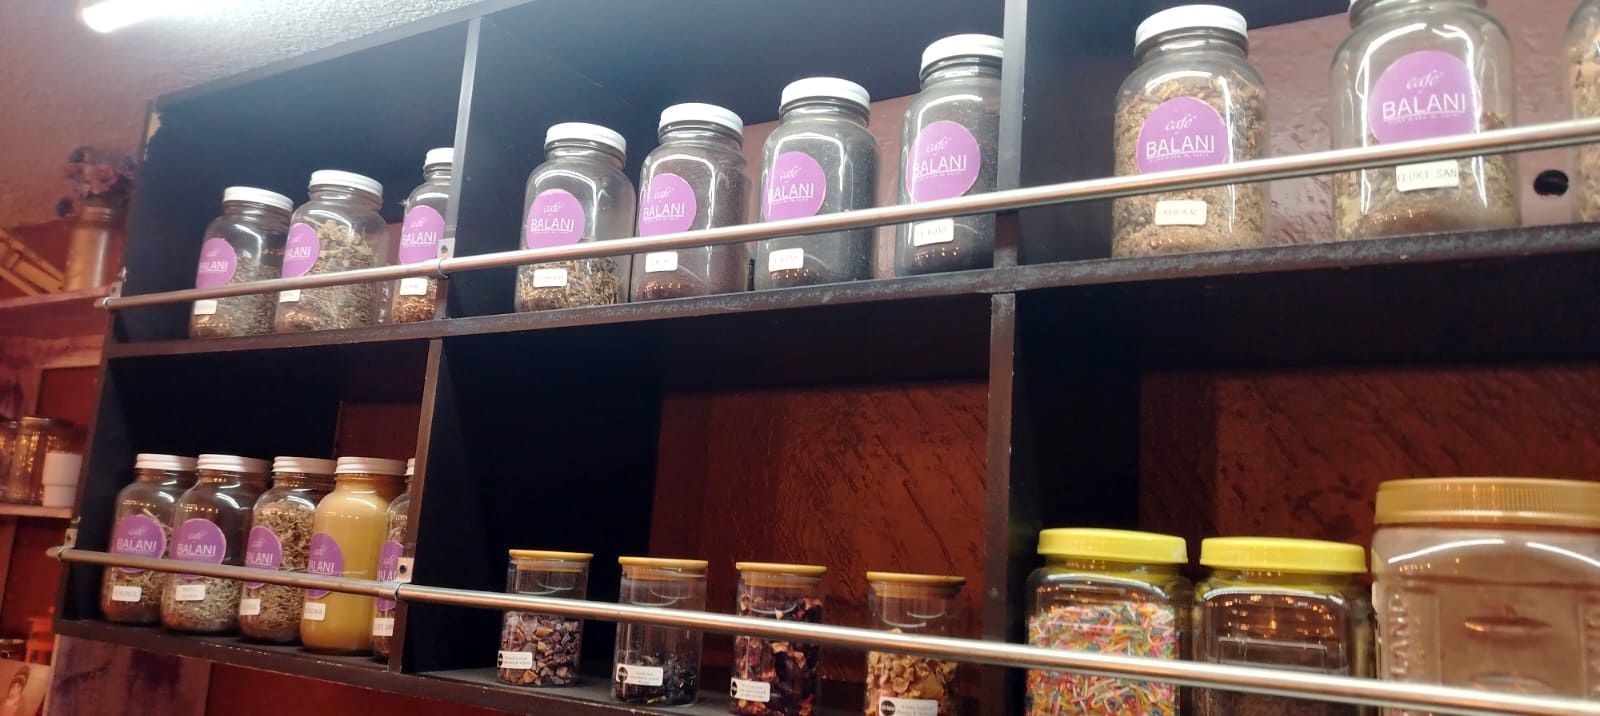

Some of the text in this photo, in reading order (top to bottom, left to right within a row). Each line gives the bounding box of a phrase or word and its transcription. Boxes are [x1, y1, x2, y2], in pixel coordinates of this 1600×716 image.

[1383, 94, 1465, 120] BALANI
[1146, 135, 1214, 159] BALANI
[913, 154, 967, 177] BALANI
[643, 203, 684, 219] BALANI
[531, 218, 574, 232] BALANI
[117, 539, 156, 552] BALANI
[177, 544, 216, 556] BALANI
